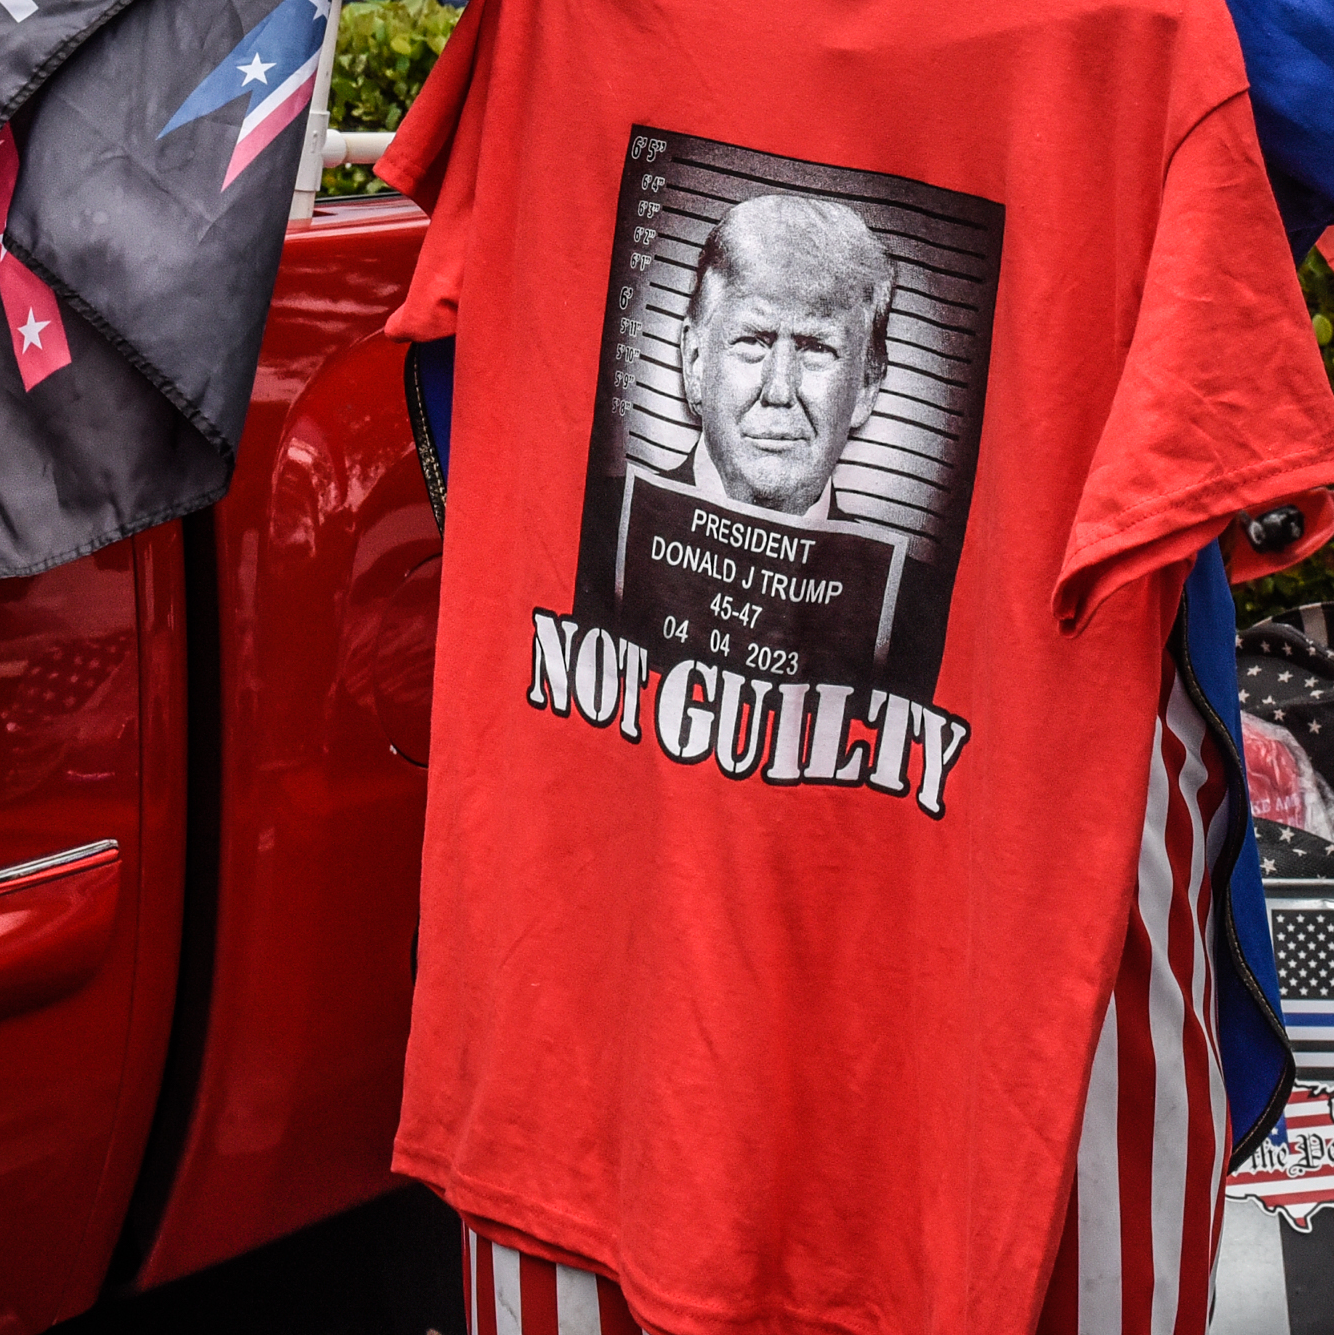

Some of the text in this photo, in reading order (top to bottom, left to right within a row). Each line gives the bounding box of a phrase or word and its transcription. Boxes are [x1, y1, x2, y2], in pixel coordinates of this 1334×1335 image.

[690, 508, 816, 564] PRESIDENT
[650, 535, 843, 605] DONALD J TRUMP
[709, 592, 763, 629] 45-47
[662, 615, 799, 676] 04 04 2023
[527, 610, 969, 817] NOT GUILTY
